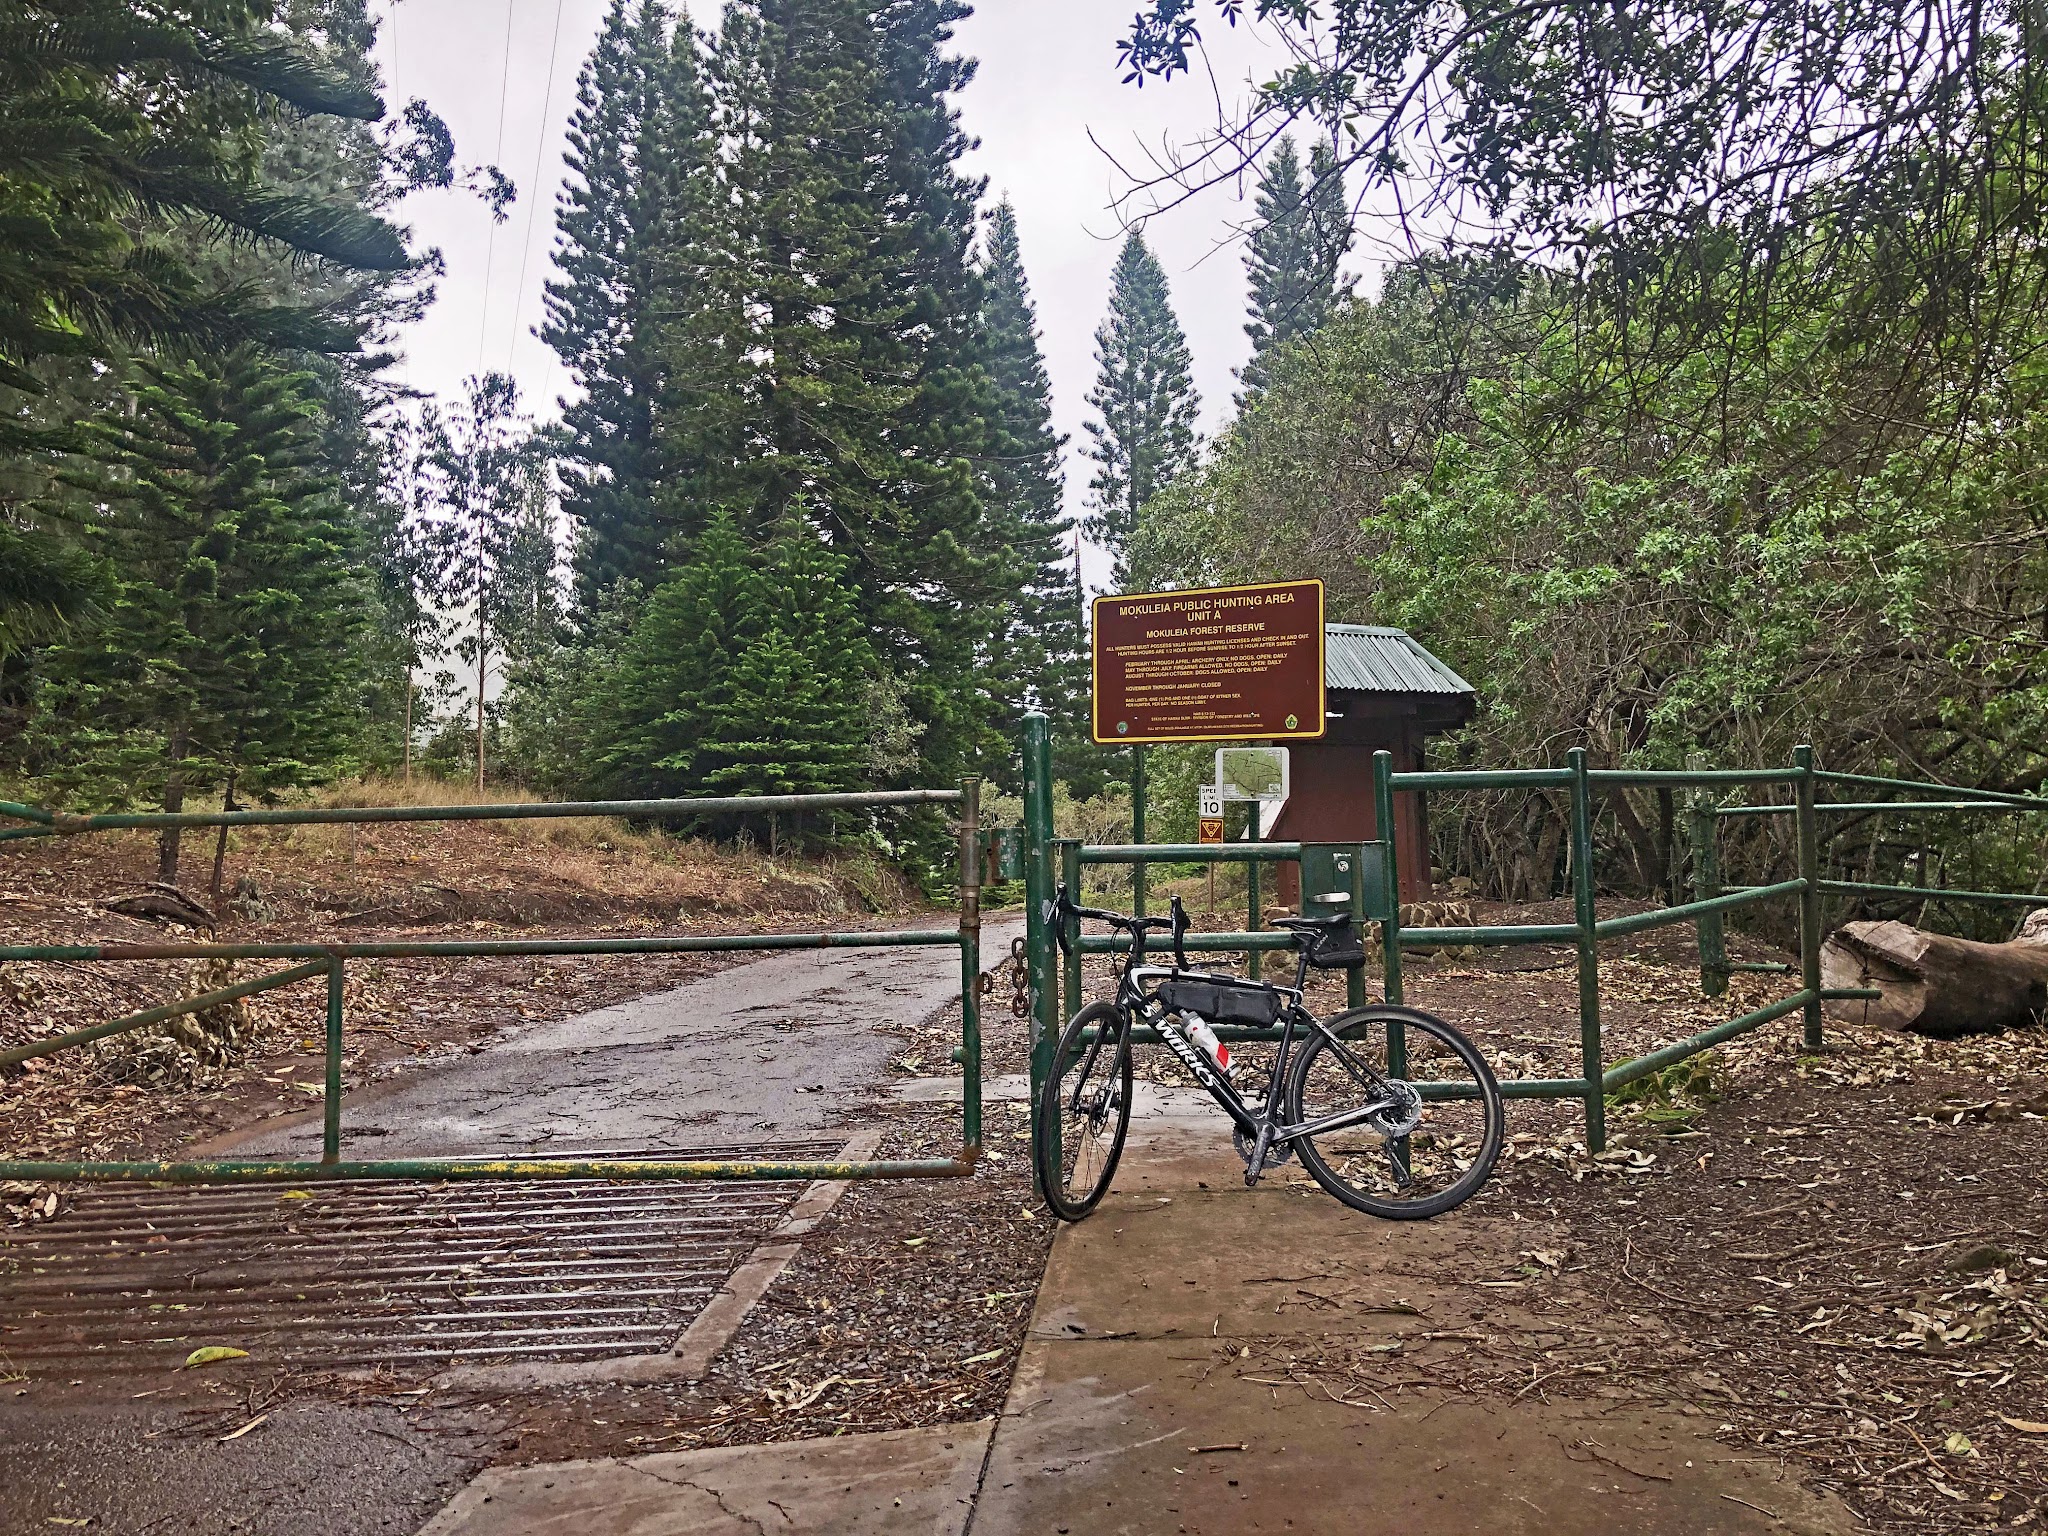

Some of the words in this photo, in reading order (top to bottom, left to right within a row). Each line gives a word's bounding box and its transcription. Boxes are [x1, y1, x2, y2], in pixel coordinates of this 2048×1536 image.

[1120, 603, 1171, 616] MOKULEIA
[1174, 600, 1212, 611] PUBLIC
[1214, 596, 1262, 608] HUNTING
[1265, 593, 1294, 604] AREA
[1188, 611, 1212, 622] UNIT
[1214, 610, 1222, 620] A
[1146, 628, 1188, 638] MOKULEIA
[1191, 626, 1223, 636] FOREST
[1226, 622, 1264, 632] RESERVE
[1204, 802, 1218, 814] 10
[1141, 1005, 1220, 1086] SWORKS
